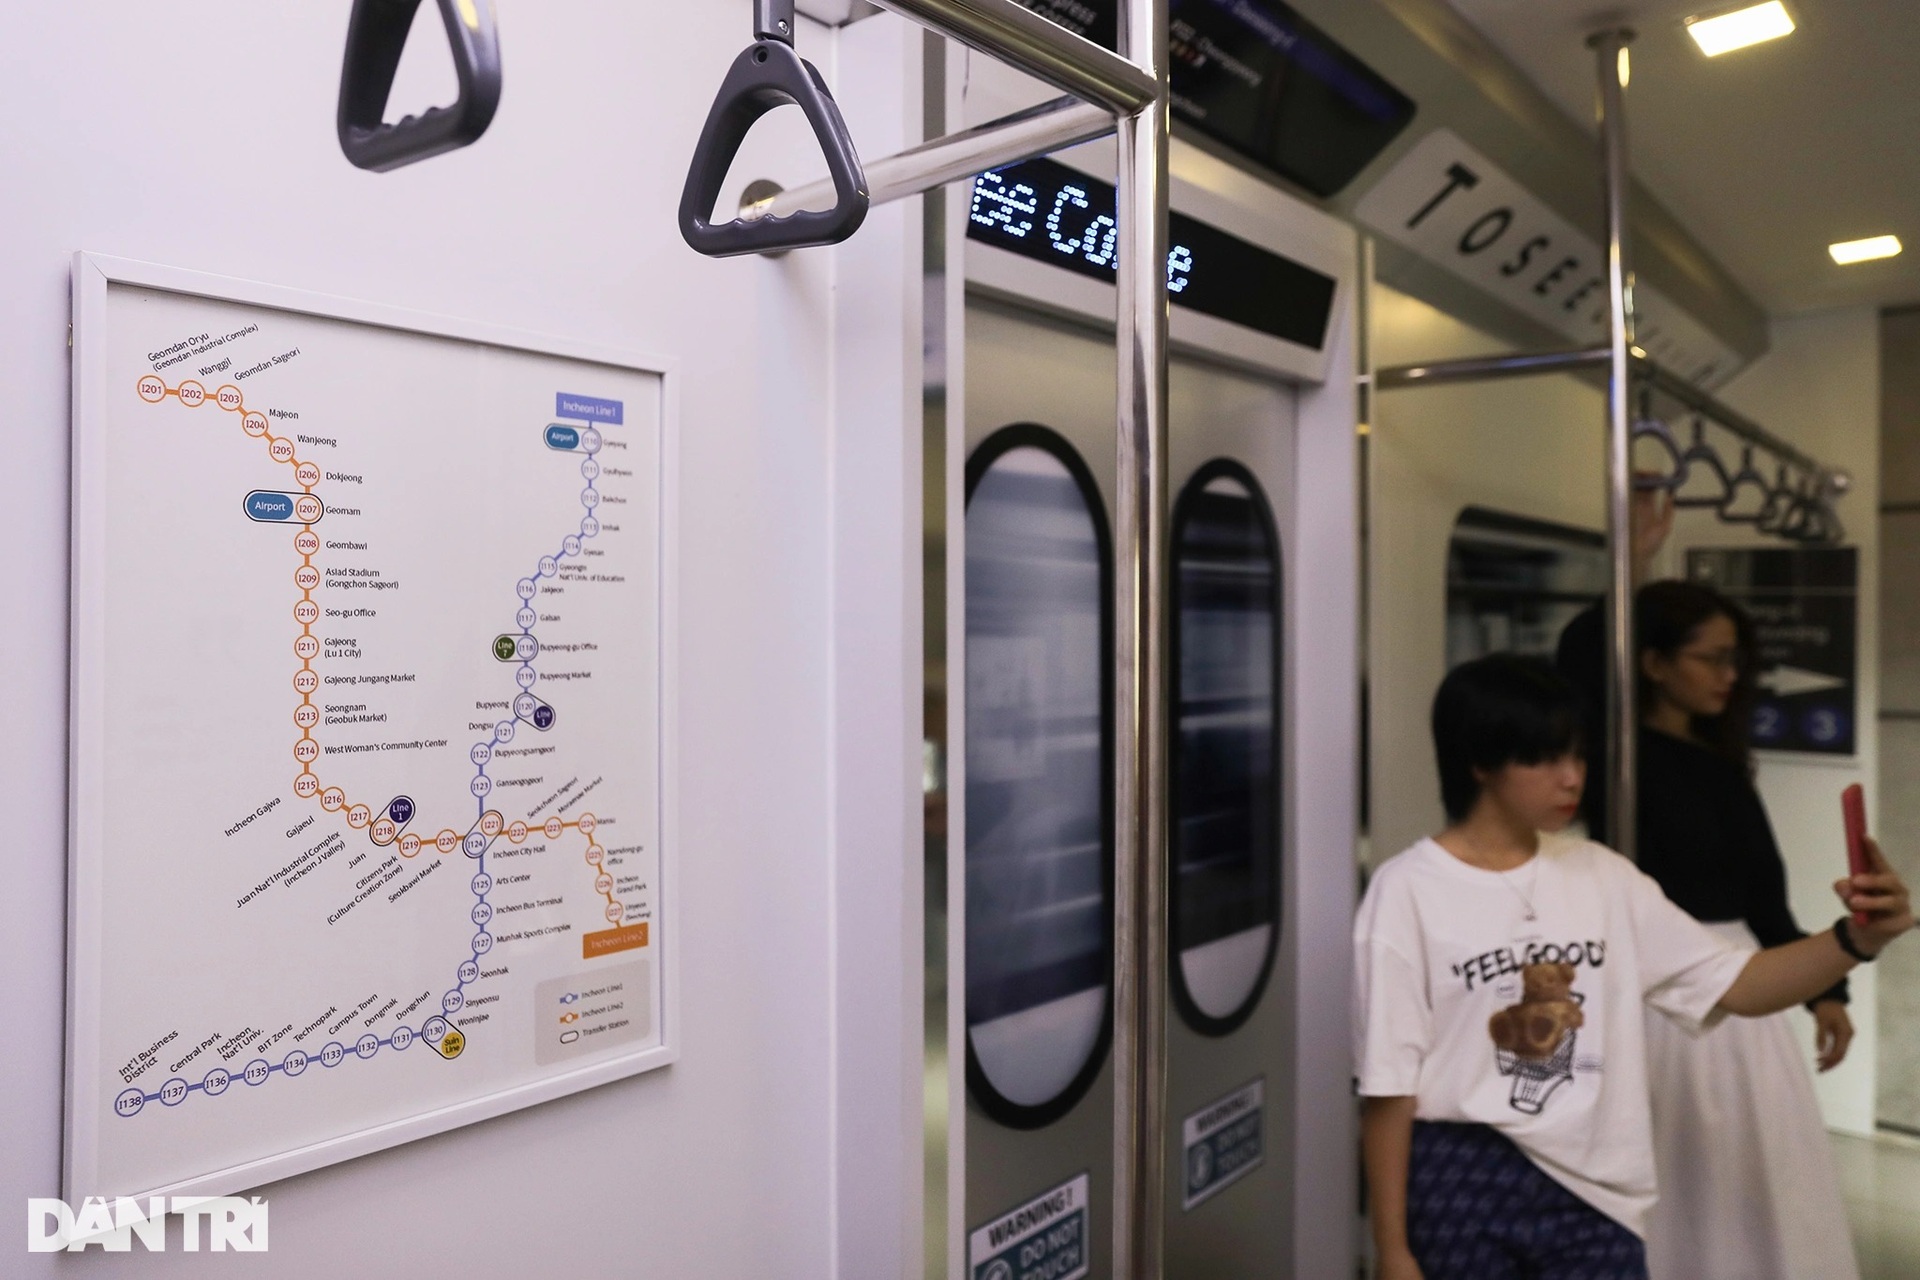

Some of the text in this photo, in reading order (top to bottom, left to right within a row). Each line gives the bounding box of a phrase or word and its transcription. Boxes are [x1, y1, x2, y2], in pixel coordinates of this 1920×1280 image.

[1046, 185, 1193, 293] Coe
[148, 332, 210, 362] Geomdan Oryu
[152, 323, 259, 373] (Geomdan Industrial Complex)
[198, 357, 232, 377] Wanggil
[234, 347, 300, 382] Geomdan Sageori
[269, 409, 299, 420] Majeon
[297, 435, 336, 447] Wanjeong
[552, 432, 574, 442] Airport
[326, 472, 362, 484] Dokjeong
[255, 501, 286, 512] Airport
[326, 506, 361, 516] Geomam
[326, 541, 367, 550] Geombawi
[326, 568, 380, 577] Asiad Stadium
[326, 579, 399, 590] (Gongchon Sageori)
[326, 608, 376, 618] Seo-gu Office
[325, 638, 356, 647] Gajeong
[344, 648, 361, 658] City)
[324, 674, 415, 685] Gajeong Jungang Market
[325, 703, 366, 714] Seongnam
[476, 701, 509, 710] Bupyeong
[325, 713, 387, 725] (Geobuk Market)
[1811, 709, 1838, 742] 3
[325, 739, 448, 755] West Woman's Community Center
[225, 797, 281, 836] Incheon Gajwa
[286, 816, 315, 838] Gajaeul
[348, 853, 366, 869] Juan
[493, 850, 523, 859] Incheon
[521, 847, 533, 856] City
[236, 890, 257, 908] Juan
[273, 852, 309, 882] Industrial
[308, 831, 340, 858] Complex
[284, 863, 318, 888] (Incheon
[321, 840, 346, 859] Valley)
[355, 855, 398, 889] Citizens Park
[388, 859, 442, 903] Seokbawi Market
[511, 875, 531, 883] Center
[327, 864, 403, 925] (Culture Creation Zone)
[496, 905, 522, 914] Incheon
[524, 930, 543, 939] Sports
[592, 936, 622, 948] Incheon
[480, 967, 509, 979] Seonhak
[396, 990, 431, 1021] Dongchun
[465, 995, 500, 1008] Sinyeonsu
[328, 993, 378, 1036] Campus Town
[364, 998, 398, 1028] Dongmak
[458, 1014, 490, 1027] Woninjae
[293, 1006, 337, 1043] Technopark
[583, 1020, 629, 1036] Transfer Station
[217, 1026, 252, 1055] Incheon
[221, 1029, 264, 1062] Nat'l Univ.
[257, 1023, 293, 1054] BIT Zone
[444, 1036, 460, 1045] Suin
[118, 1030, 178, 1077] Int'l Business
[169, 1032, 222, 1073] Central Park
[445, 1044, 460, 1053] Line
[124, 1056, 158, 1084] District
[1020, 1218, 1080, 1268] DO NOT
